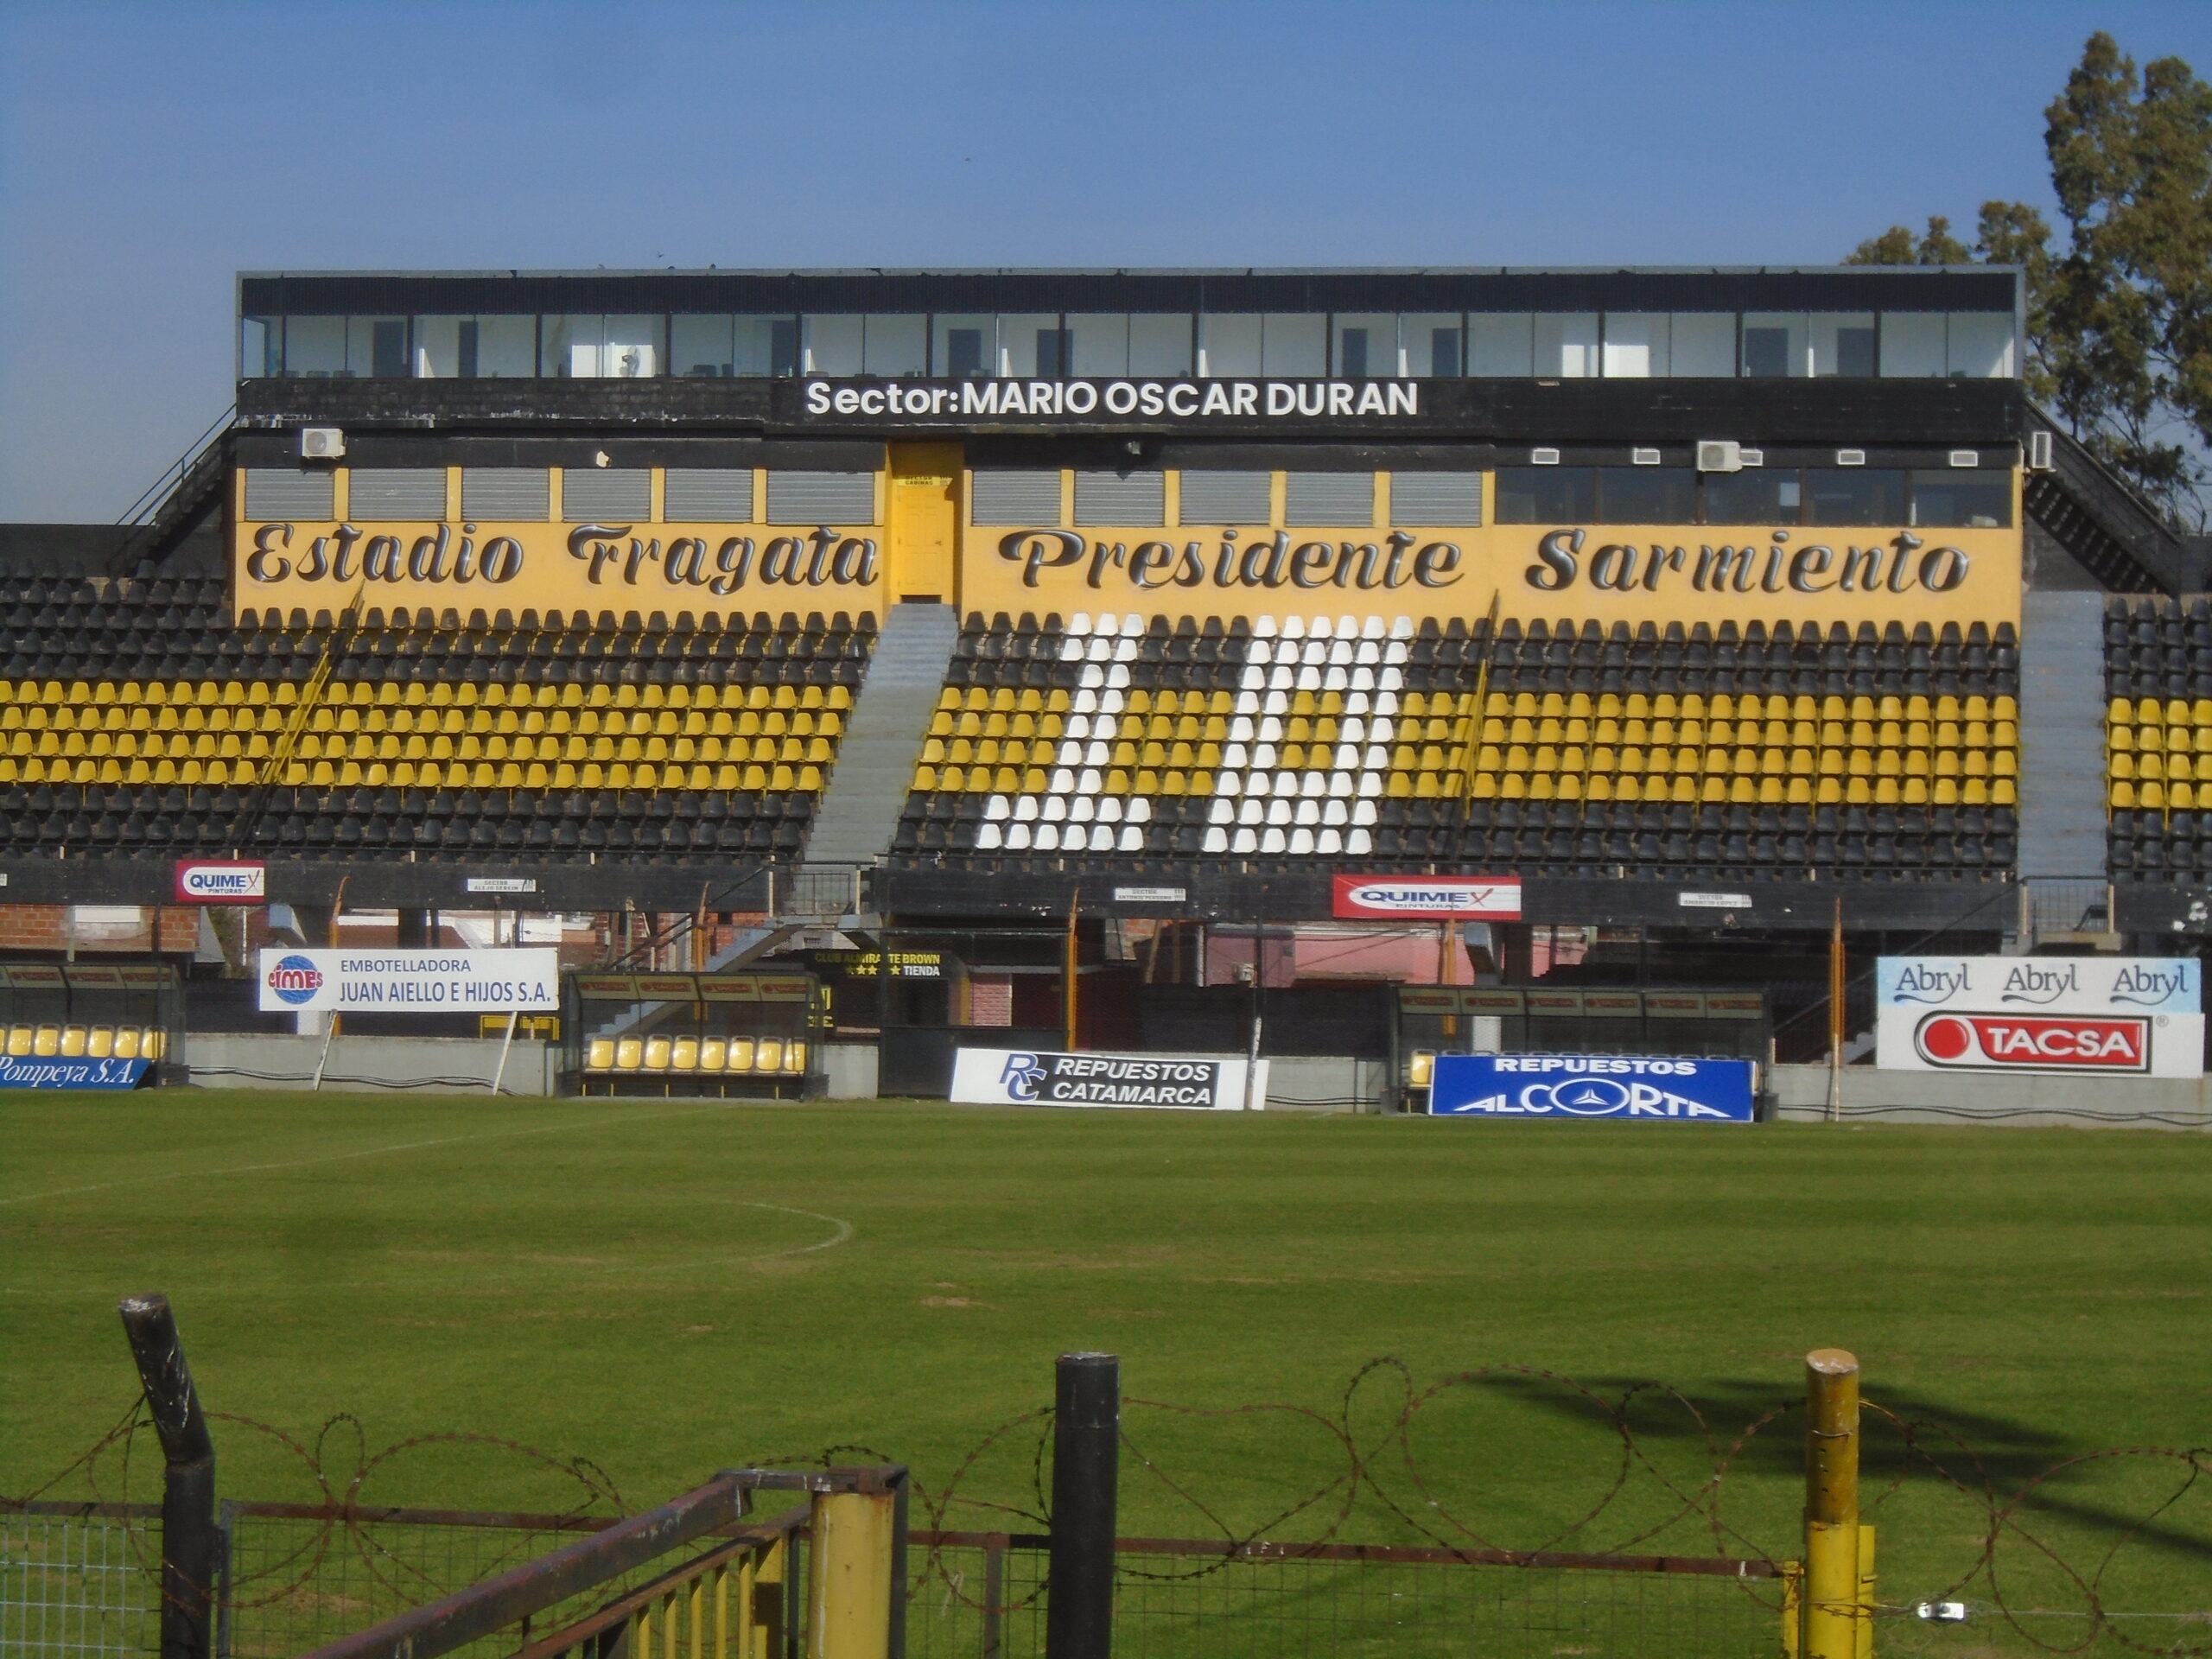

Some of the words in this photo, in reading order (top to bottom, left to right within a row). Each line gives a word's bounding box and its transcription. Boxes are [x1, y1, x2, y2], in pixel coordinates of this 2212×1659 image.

[1105, 381, 1258, 416] OSCAR
[1267, 383, 1418, 416] DURAN
[246, 524, 524, 585] Estadio
[567, 524, 880, 596] Fragata
[998, 529, 1465, 590] Presidente
[1525, 528, 1971, 594] Sarmiento
[190, 869, 260, 893] QUIMEX
[1361, 887, 1494, 908] QUIMEX
[341, 959, 472, 972] EMBOTELLADORA
[844, 953, 900, 963] ALMIRATE
[903, 955, 940, 963] BROWN
[903, 966, 940, 976] TIENDA
[340, 982, 383, 1002] JUAN
[389, 982, 444, 1002] AIELLO
[451, 982, 460, 1001] E
[466, 982, 512, 1002] HIJOS
[518, 982, 551, 1002] S.A.
[1894, 963, 1972, 1003] Abryl
[2001, 963, 2080, 1004] Abryl
[2109, 965, 2189, 1006] Abryl
[1988, 1027, 2135, 1058] TACSA
[0, 1056, 89, 1087] Pompeya
[90, 1058, 134, 1084] S.A.
[1055, 1058, 1211, 1081] REPUESTOS
[1494, 1058, 1697, 1075] REPUESTOS
[1053, 1082, 1211, 1104] CATAMARCA
